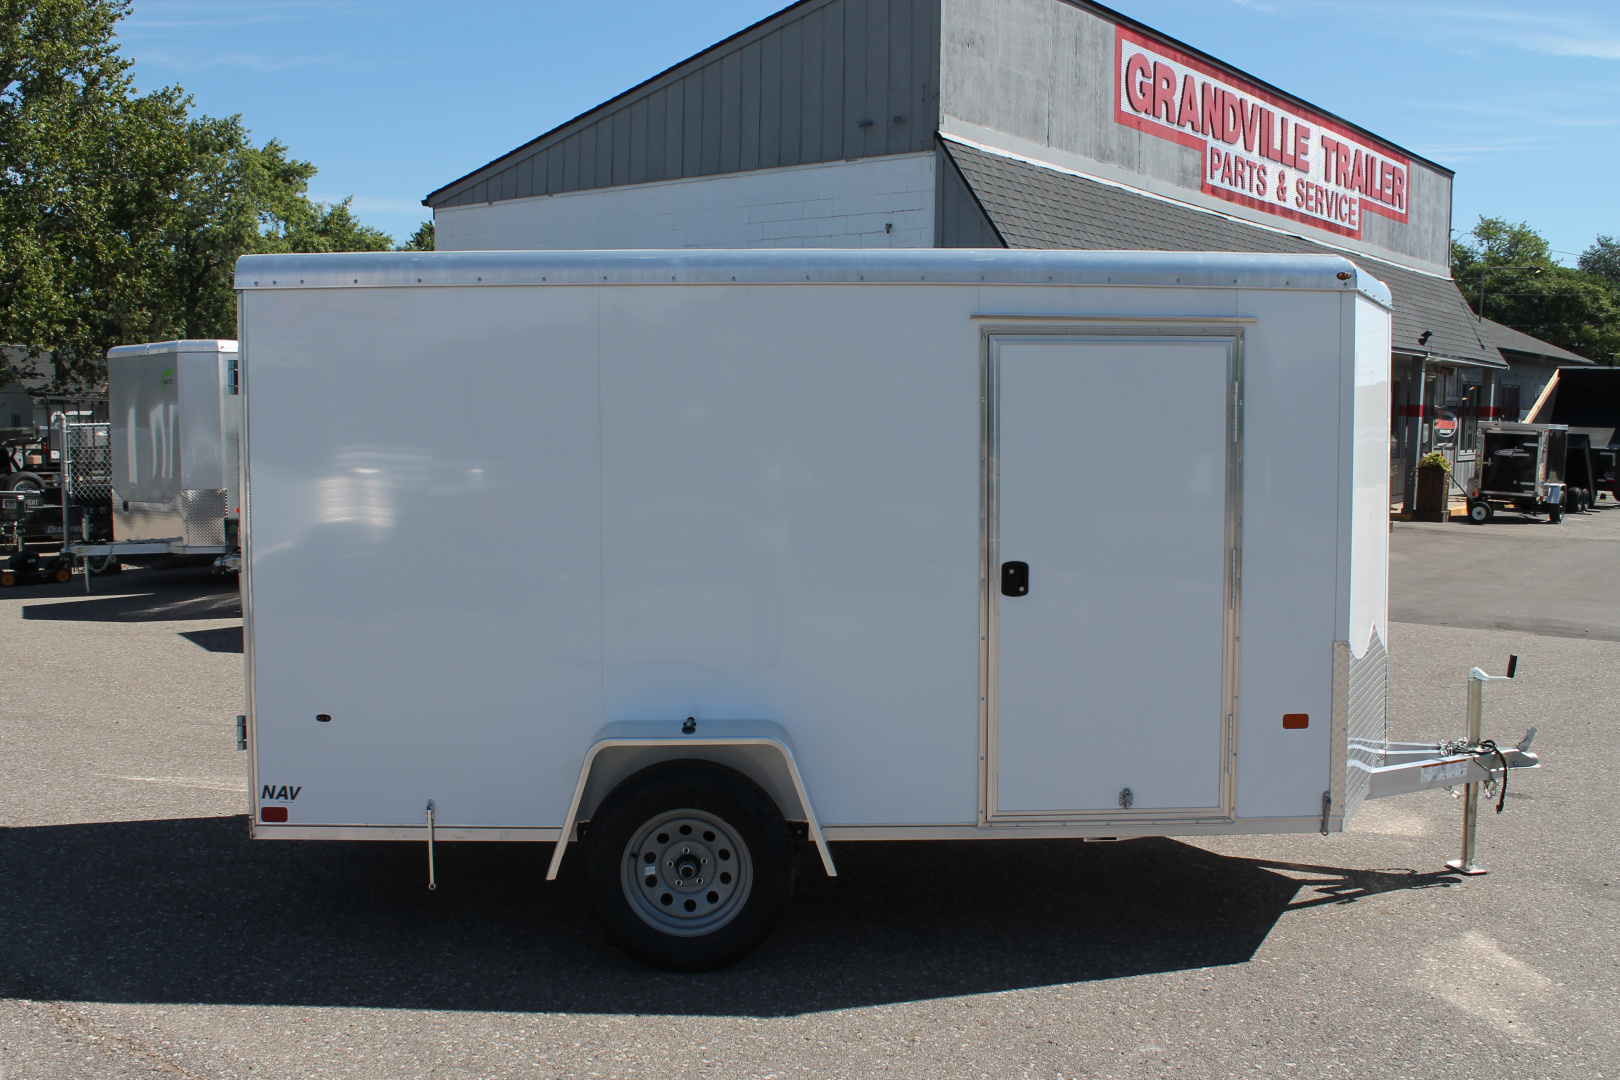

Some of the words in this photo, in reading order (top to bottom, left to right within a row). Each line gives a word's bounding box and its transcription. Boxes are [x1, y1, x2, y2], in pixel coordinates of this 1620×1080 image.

[1126, 52, 1310, 174] GRANDVILLE
[1321, 134, 1405, 210] TRAILER
[1210, 146, 1268, 197] PARTS
[1276, 170, 1287, 203] &
[1295, 177, 1358, 226] SERVICE
[261, 784, 302, 800] NAV
